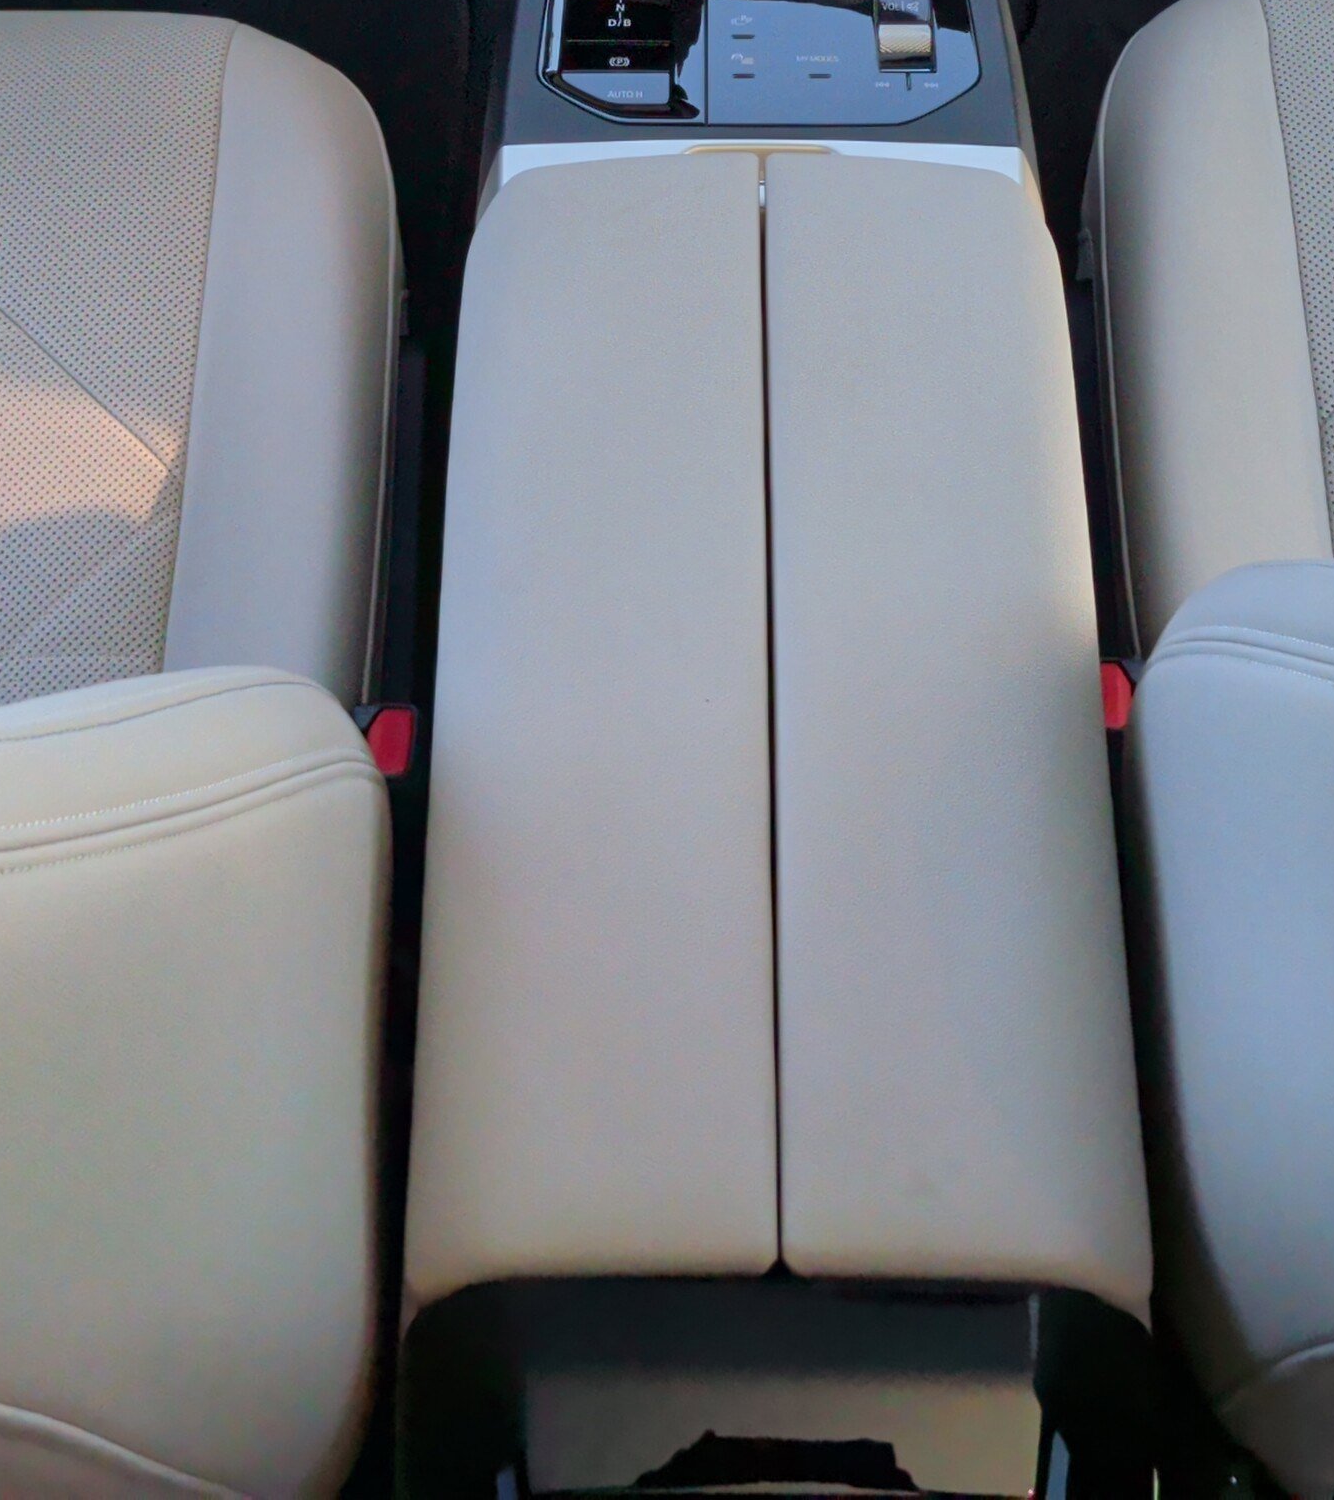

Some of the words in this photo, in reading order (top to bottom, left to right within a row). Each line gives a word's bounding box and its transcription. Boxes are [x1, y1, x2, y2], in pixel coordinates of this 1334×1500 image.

[616, 3, 626, 12] N
[881, 1, 901, 11] VOL
[607, 90, 633, 99] AUTO
[635, 90, 644, 99] H
